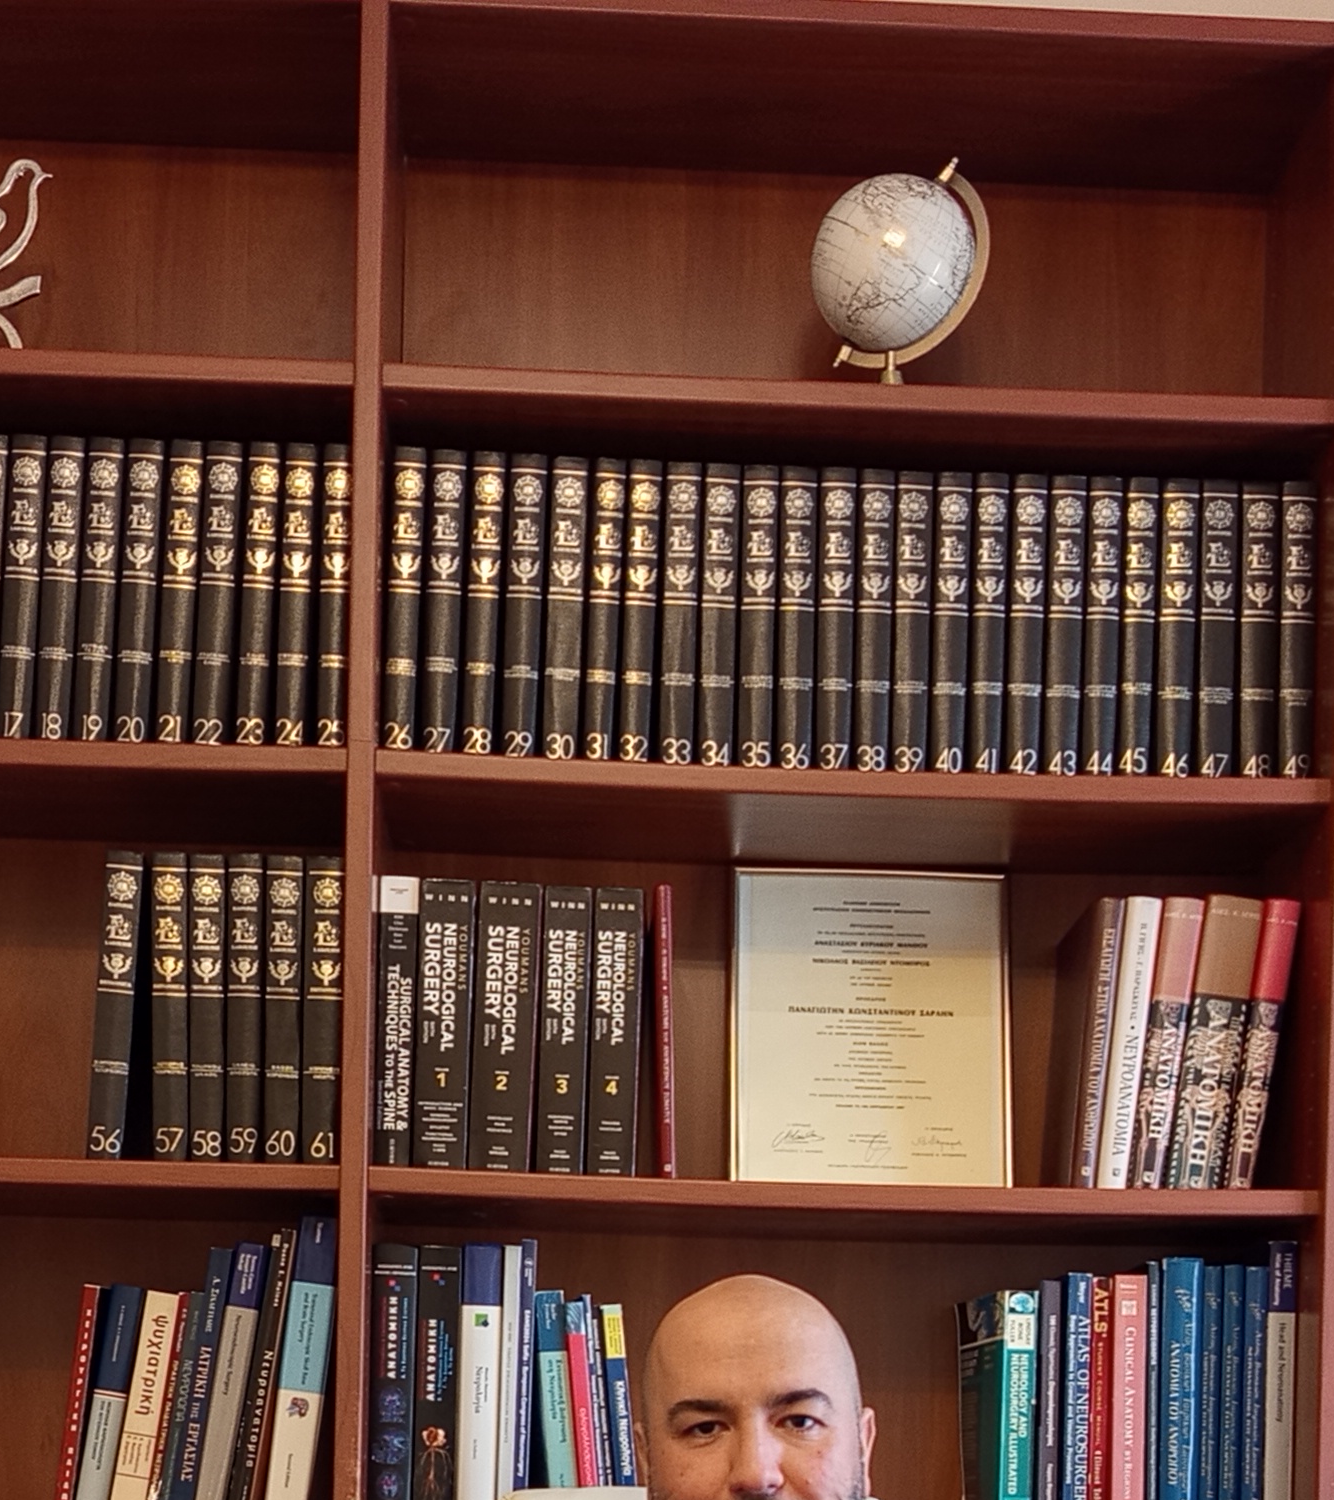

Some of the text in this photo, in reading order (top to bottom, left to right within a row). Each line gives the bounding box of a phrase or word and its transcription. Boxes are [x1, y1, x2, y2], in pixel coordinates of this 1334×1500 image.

[3, 711, 24, 739] 17
[41, 712, 62, 739] 18
[82, 714, 103, 741] 19
[116, 715, 145, 743] 20
[158, 714, 182, 742] 21
[193, 718, 223, 745] 22
[235, 717, 265, 746] 23
[276, 718, 303, 746] 24
[385, 722, 413, 750] 26
[423, 726, 451, 754] 27
[463, 725, 492, 754] 28
[504, 730, 533, 757] 29
[545, 732, 574, 760] 30
[586, 732, 608, 760] 31
[619, 734, 648, 762] 32
[662, 737, 691, 765] 33
[701, 740, 728, 767] 34
[741, 741, 771, 768] 35
[780, 742, 809, 770] 36
[820, 743, 848, 770] 37
[856, 744, 885, 773] 38
[894, 745, 923, 773] 39
[935, 747, 962, 774] 40
[975, 747, 997, 775] 41
[1009, 748, 1037, 776] 42
[1048, 750, 1077, 777] 43
[1086, 750, 1112, 776] 44
[1118, 747, 1148, 775] 45
[1161, 752, 1189, 779] 46
[1200, 753, 1229, 779] 47
[423, 921, 442, 1016] SURGERY
[457, 924, 469, 992] YOUMANS
[484, 924, 504, 1020] SURGERY
[519, 927, 531, 995] YOUMANS
[546, 928, 563, 1014] SURGERY
[575, 931, 586, 991] YOUMANS
[595, 929, 612, 1015] SURGERY
[626, 932, 636, 992] YOUMANS
[440, 921, 458, 1052] NEUROLOGICAL
[500, 925, 520, 1056] NEUROLOGICAL
[561, 929, 577, 1046] NEUROLOGICAL
[610, 930, 627, 1047] NEUROLOGICAL
[382, 963, 401, 1131] TECHNIQUES TO THE SPINE
[395, 977, 413, 1132] SURGICAL ANATOMY &
[436, 1072, 448, 1088] 1
[495, 1074, 508, 1092] 2
[555, 1078, 568, 1095] 3
[605, 1078, 618, 1096] 4
[1148, 1021, 1178, 1140] ΑΝΑΤΟΜΙΚΗ
[1188, 1011, 1229, 1165] ΑΝΑΤΟΜΙΚΗ
[1240, 1023, 1273, 1154] ΑΝΑΤΟΜΙΚΗ
[1111, 1034, 1140, 1157] ΝΕΥΡΟΑΝΑΤΟΜΙΑ
[90, 1126, 121, 1153] 56
[155, 1127, 184, 1152] 57
[192, 1130, 222, 1157] 58
[229, 1127, 258, 1154] 59
[265, 1130, 295, 1157] 60
[310, 1131, 334, 1158] 61
[1093, 1287, 1109, 1333] ATLS
[386, 1295, 399, 1379] ΑΝΑΤΟΜΙΚΗ
[1077, 1314, 1091, 1364] ATLAS
[1277, 1321, 1287, 1343] Head
[134, 1314, 169, 1417] ψυχιατρική
[192, 1345, 212, 1399] ΙΑΤΡΙΚΗ
[425, 1318, 438, 1402] ΑΝΑΤΟΜΙΚΗ
[1075, 1368, 1089, 1390] OF
[245, 1349, 275, 1469] Νευροανατομία
[1017, 1353, 1029, 1438] NEUROLOGY AND
[1007, 1353, 1019, 1495] NEUROSURGERY ILLUSTRATED
[180, 1421, 200, 1483] ΕΡΓΑΣΙΑΣ
